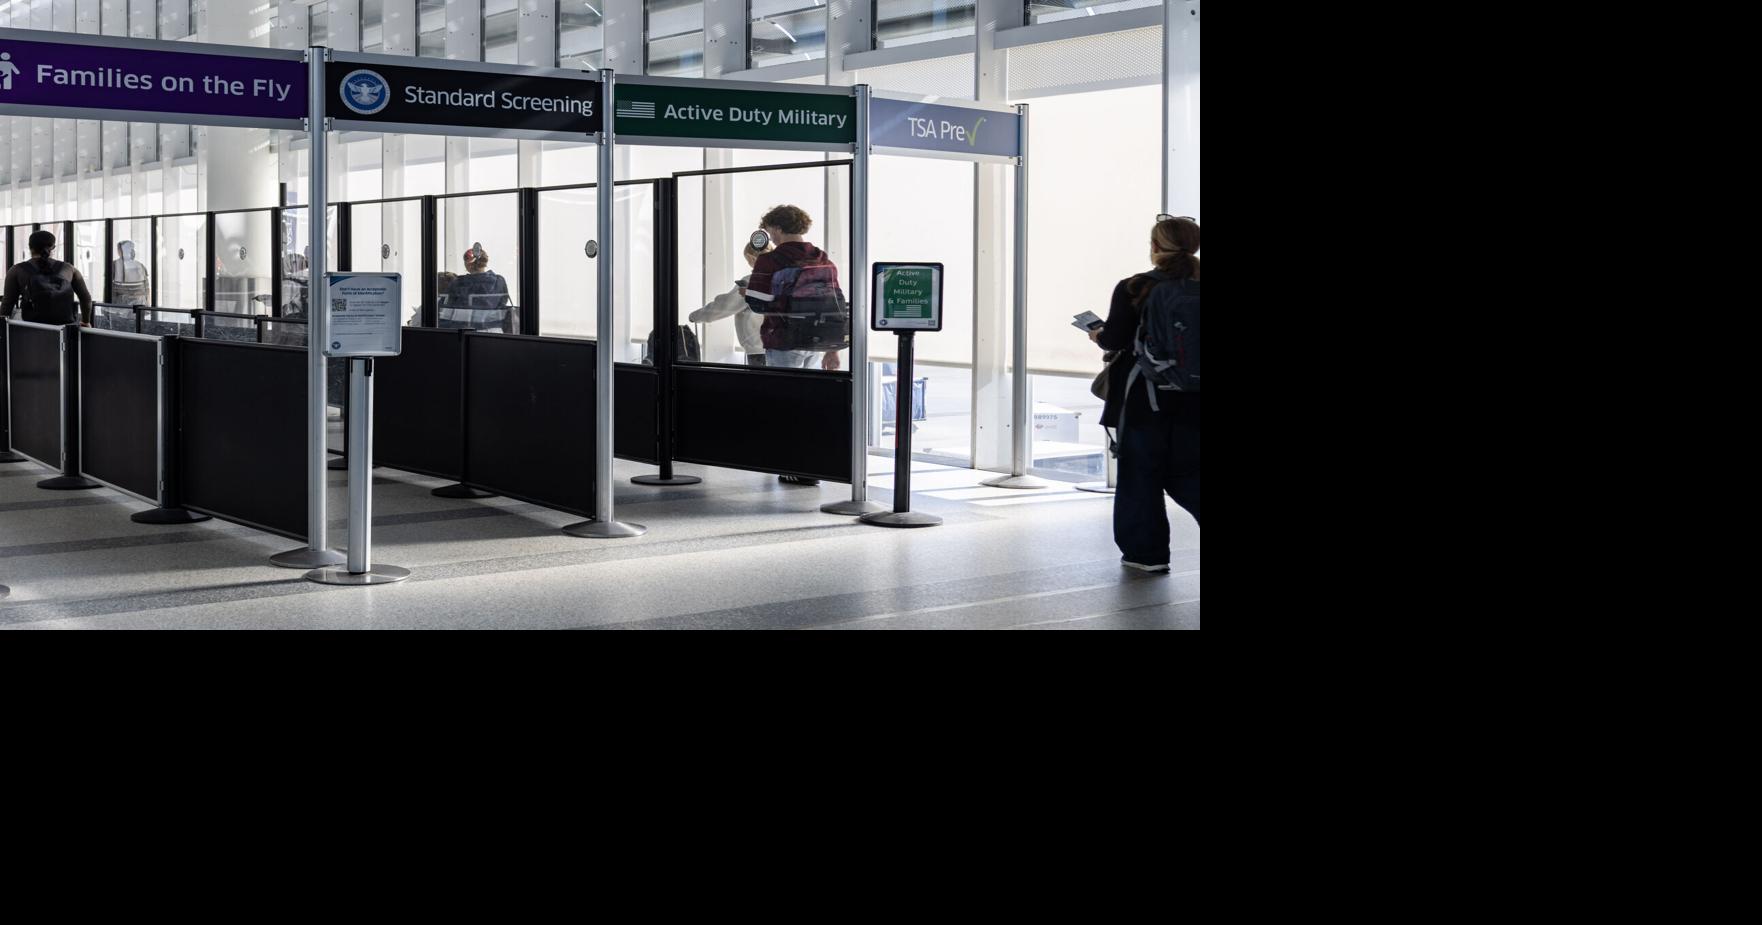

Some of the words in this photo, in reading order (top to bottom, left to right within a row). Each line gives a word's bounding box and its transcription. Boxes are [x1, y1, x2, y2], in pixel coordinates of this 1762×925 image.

[37, 64, 153, 90] Families
[161, 76, 194, 93] on
[202, 75, 244, 96] the
[253, 79, 291, 102] Fly
[405, 84, 495, 109] Standard
[501, 92, 593, 117] Screening
[664, 103, 723, 121] Active
[729, 107, 773, 126] Duty
[778, 108, 847, 129] Military
[907, 116, 937, 139] TSA
[940, 120, 966, 141] Pre
[898, 279, 918, 287] Duty
